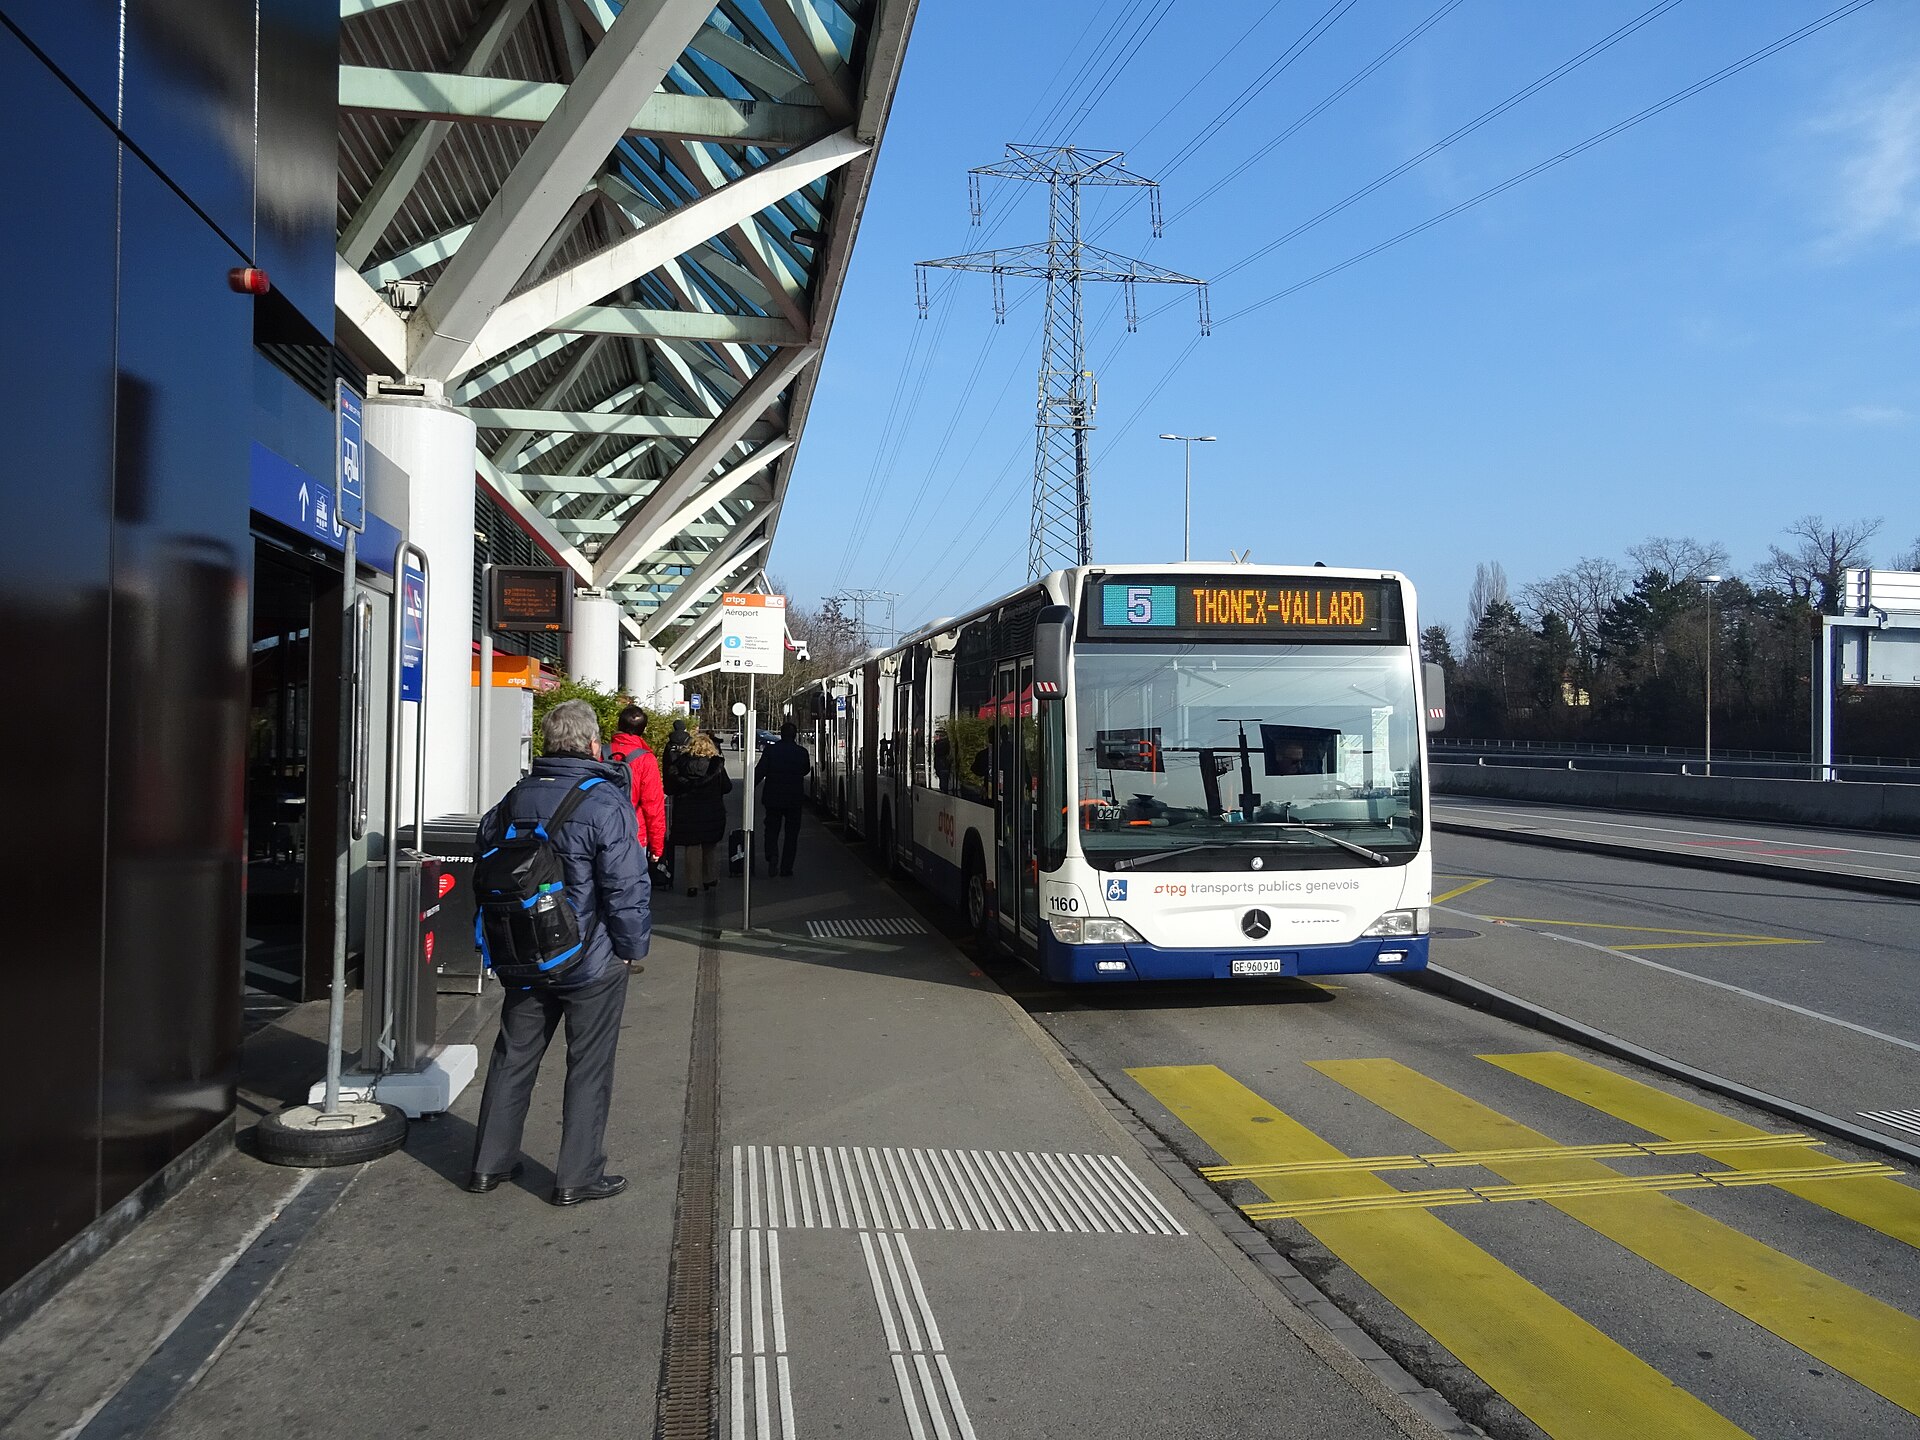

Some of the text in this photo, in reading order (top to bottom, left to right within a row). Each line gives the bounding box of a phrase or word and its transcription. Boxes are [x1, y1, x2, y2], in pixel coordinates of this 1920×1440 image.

[732, 597, 746, 605] tpg
[1127, 587, 1152, 624] 5
[1192, 589, 1365, 625] THONEX-VALLARD
[725, 609, 758, 617] Aéroport
[729, 637, 736, 646] 5
[514, 678, 527, 686] tpg
[1098, 808, 1120, 819] 027
[1165, 879, 1360, 897] tpg transports publics genevois
[1049, 896, 1079, 912] 1160
